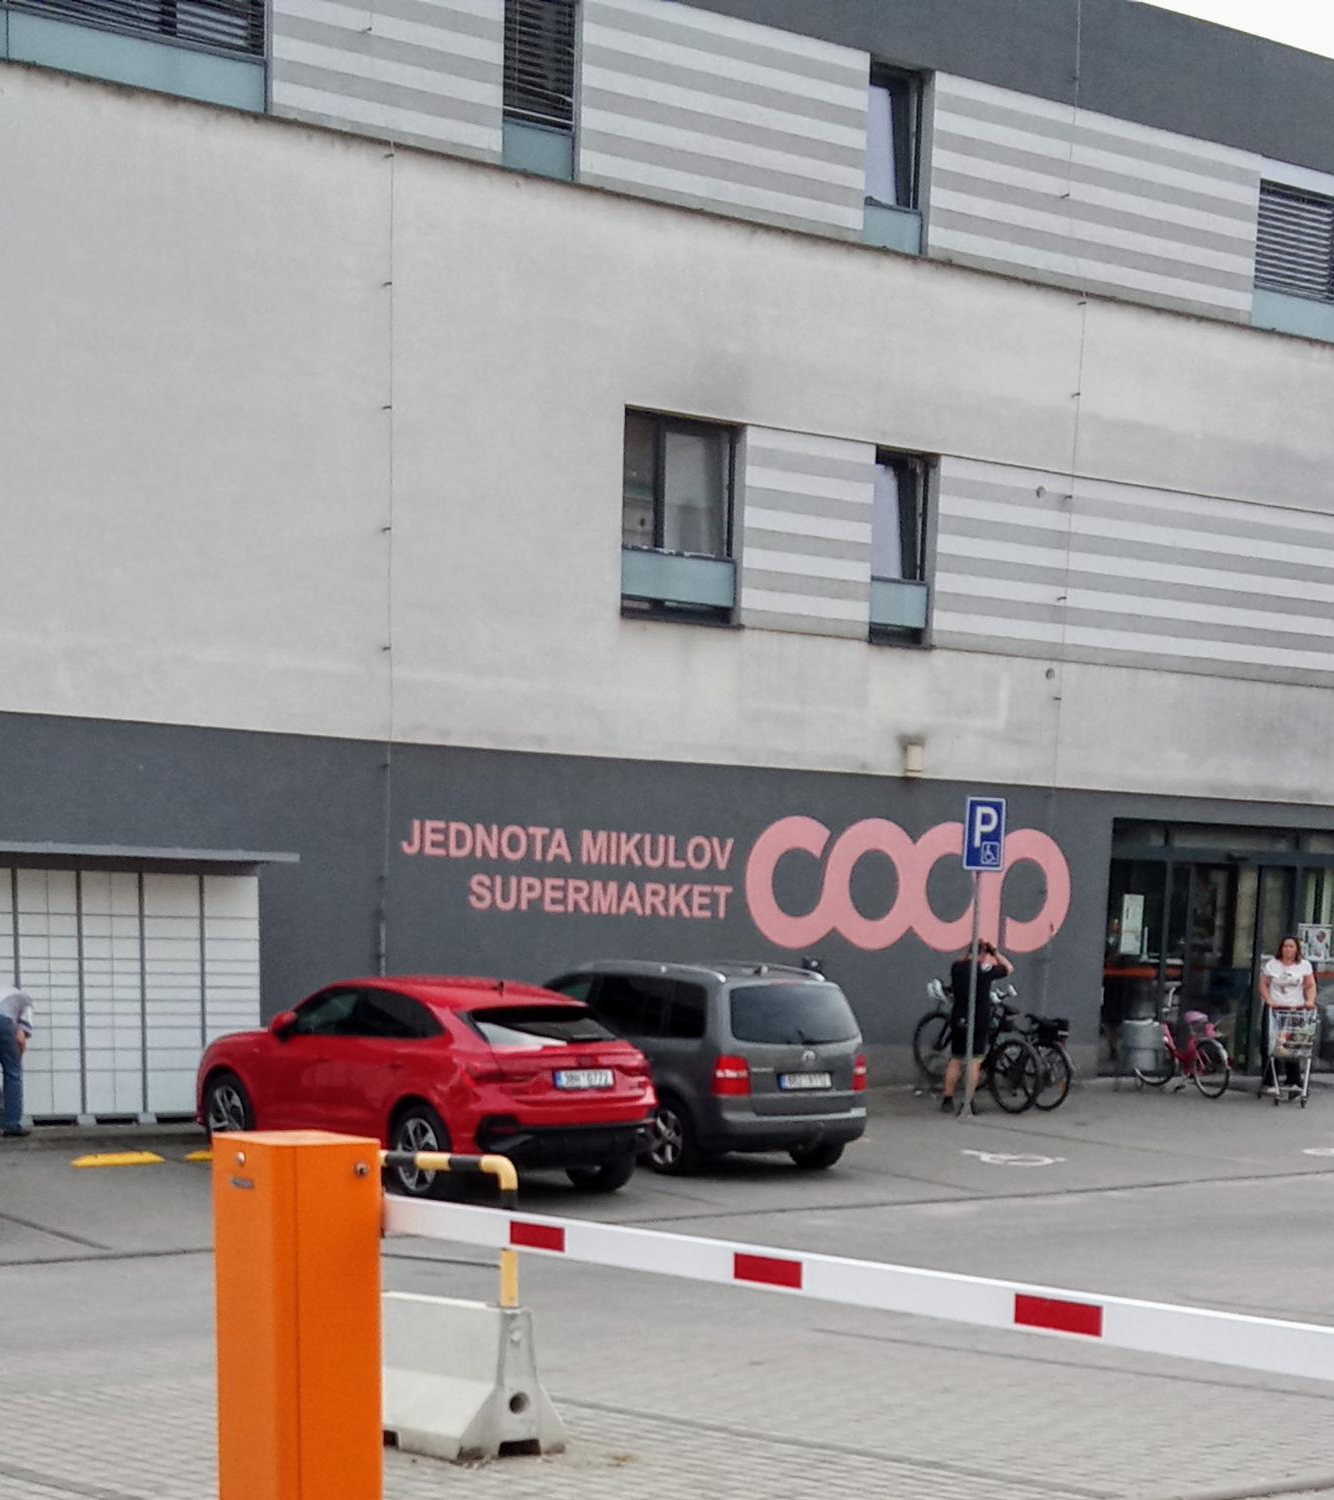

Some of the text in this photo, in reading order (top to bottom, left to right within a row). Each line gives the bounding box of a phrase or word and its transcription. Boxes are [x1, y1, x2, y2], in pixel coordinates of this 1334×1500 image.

[401, 818, 735, 871] JEDNOTA MIKULOV
[974, 806, 998, 848] P
[468, 873, 734, 920] SUPERMARKET
